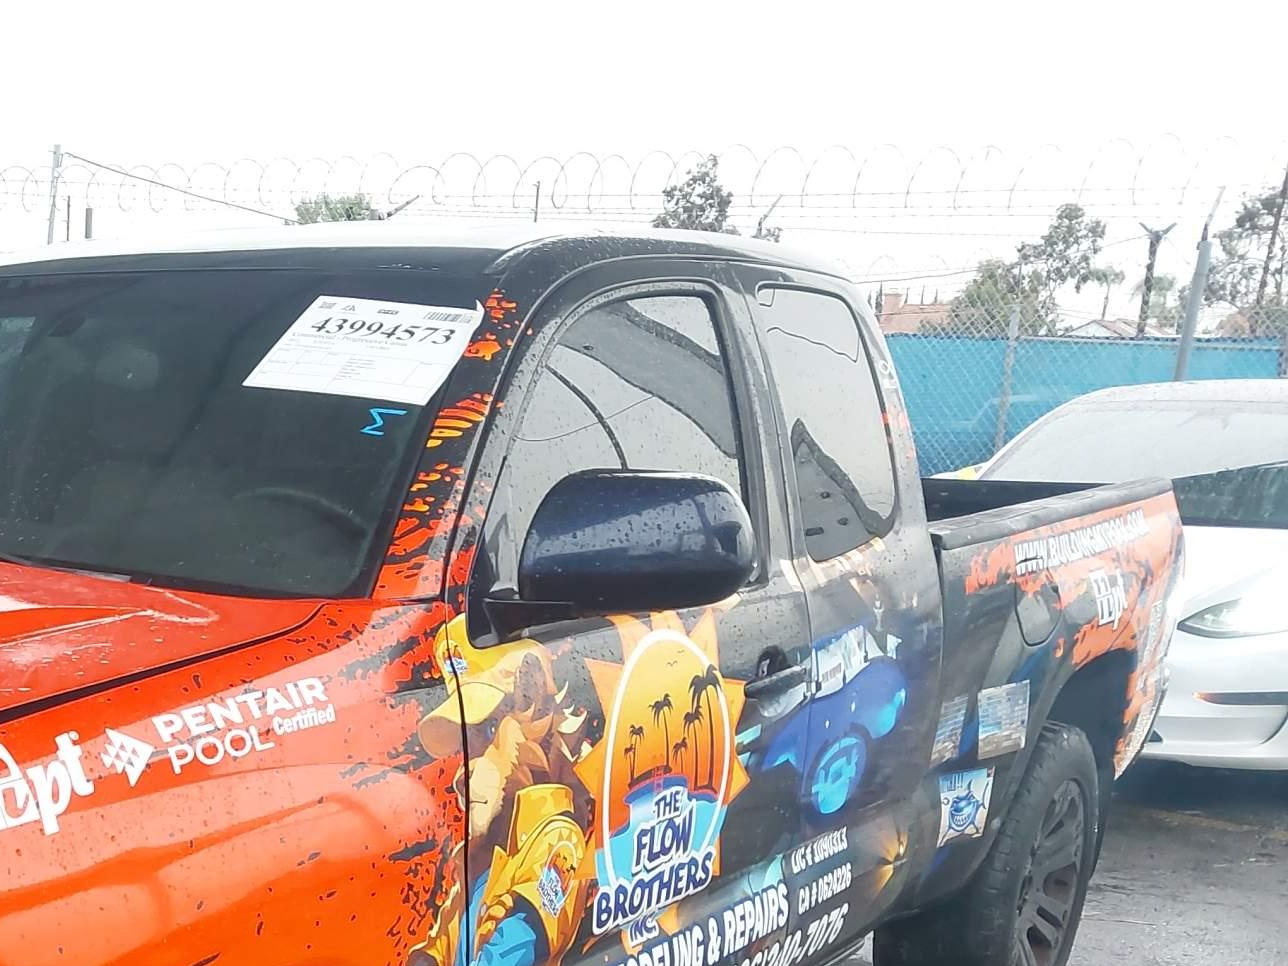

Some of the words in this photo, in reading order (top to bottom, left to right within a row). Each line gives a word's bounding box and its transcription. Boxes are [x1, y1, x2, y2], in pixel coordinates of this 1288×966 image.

[310, 317, 456, 345] 43994573
[151, 677, 330, 743] PENTAIR
[168, 725, 275, 775] POOL
[273, 704, 336, 736] Certified
[654, 789, 681, 818] THE
[635, 808, 694, 868] FLOW
[791, 847, 806, 874] LIC
[596, 851, 713, 930] BROTHERS
[798, 885, 811, 915] CA
[707, 918, 722, 966] &
[723, 883, 789, 957] REPAIRS
